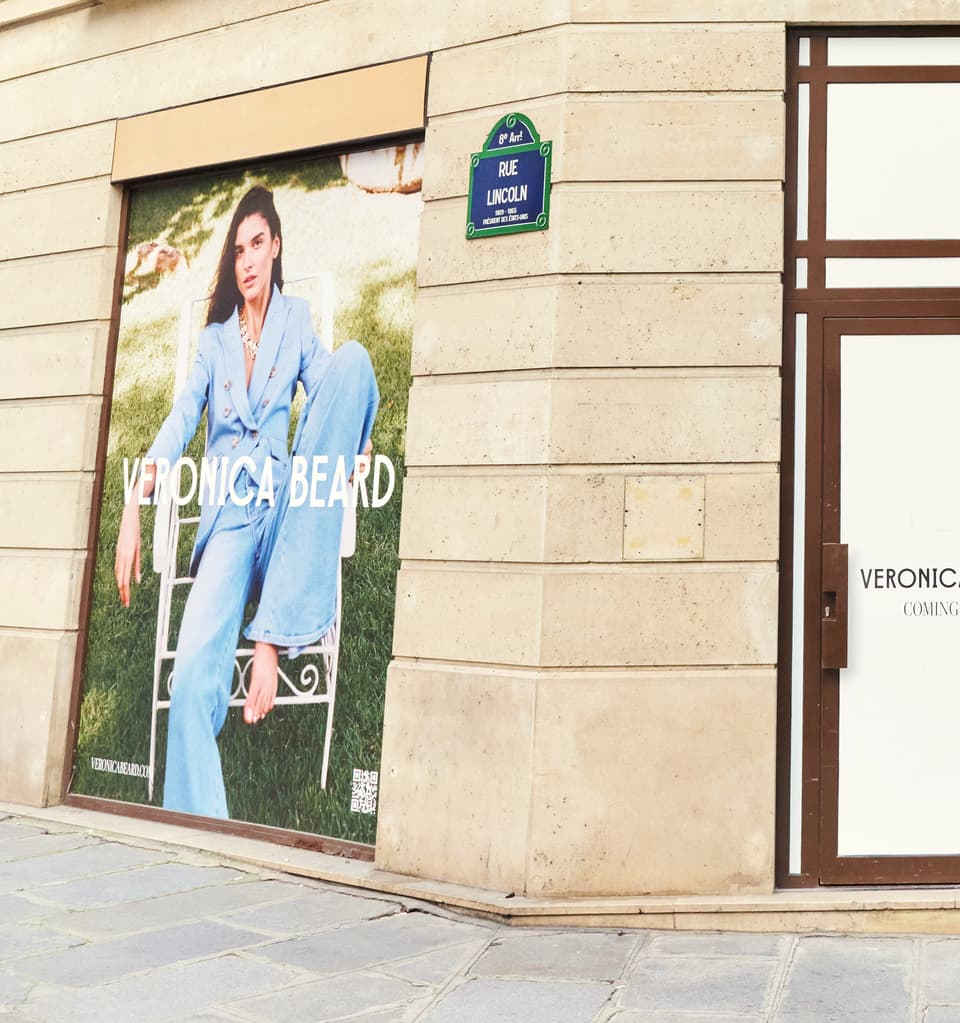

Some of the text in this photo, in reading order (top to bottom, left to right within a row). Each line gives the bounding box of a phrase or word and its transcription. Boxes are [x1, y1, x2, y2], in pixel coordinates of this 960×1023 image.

[498, 159, 519, 178] RUE
[486, 184, 528, 207] LINCOLN
[122, 455, 396, 509] VERONICA BEARD
[903, 601, 960, 617] COMING
